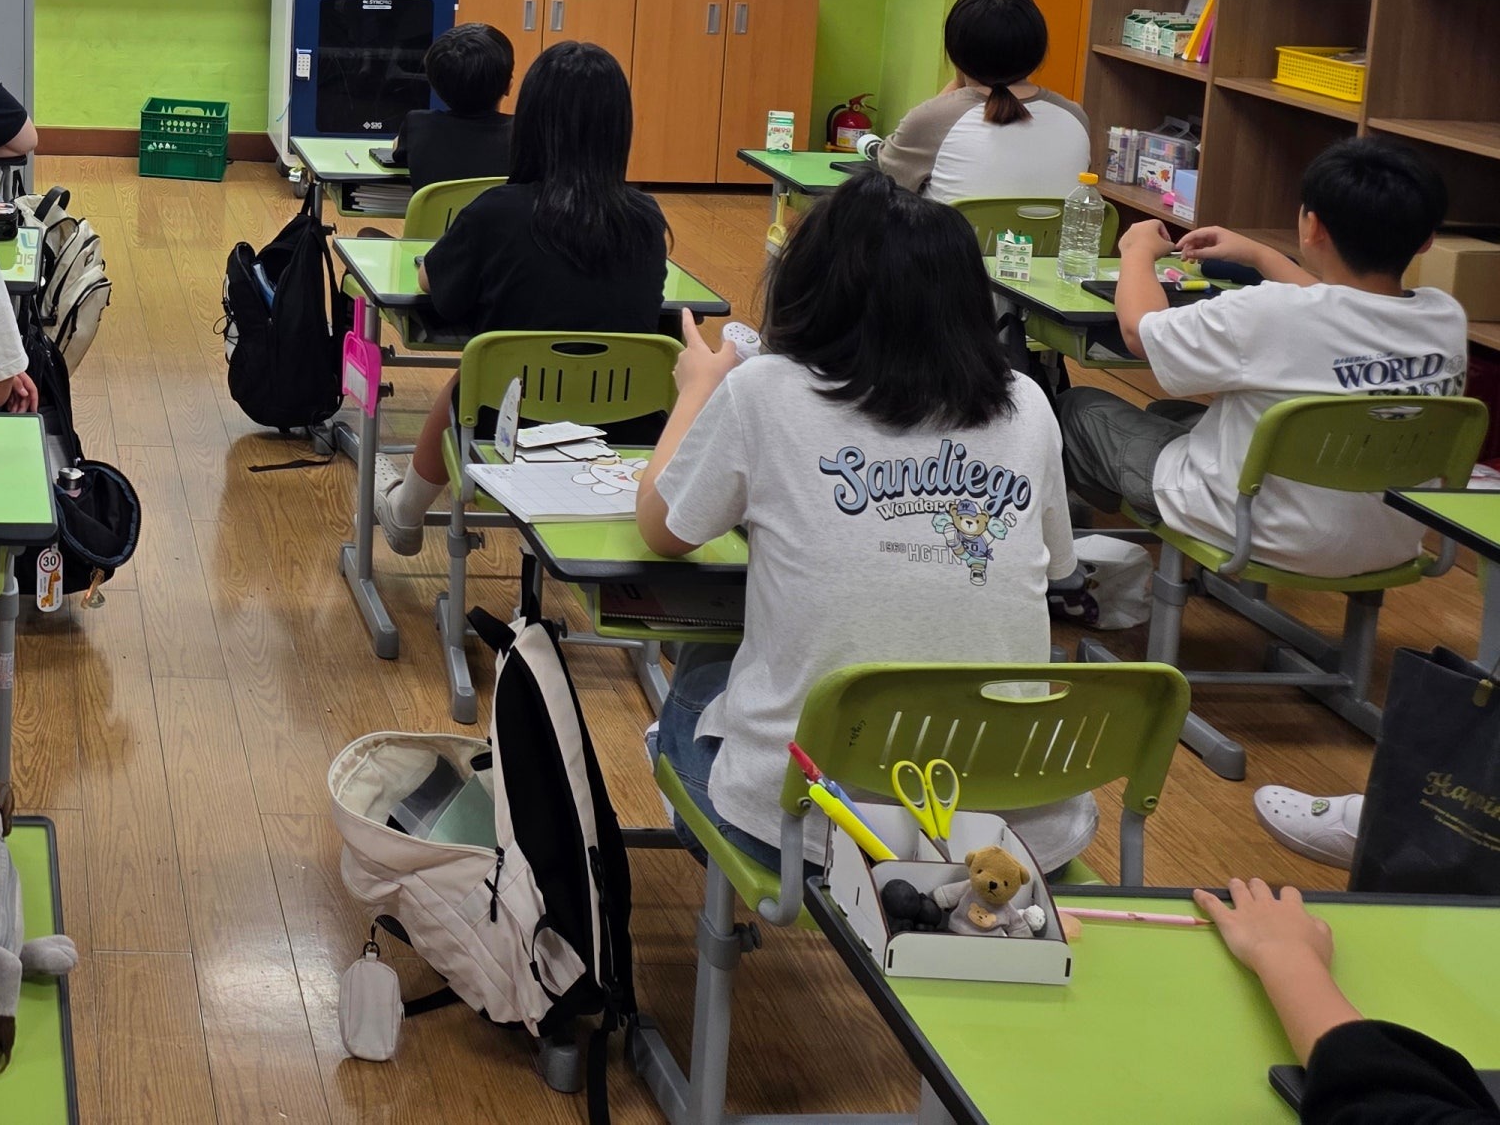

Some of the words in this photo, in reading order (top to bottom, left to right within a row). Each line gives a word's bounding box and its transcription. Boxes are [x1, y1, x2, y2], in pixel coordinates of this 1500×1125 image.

[1332, 352, 1445, 389] WORLD
[819, 439, 1031, 516] Sandiego
[42, 555, 57, 568] 30
